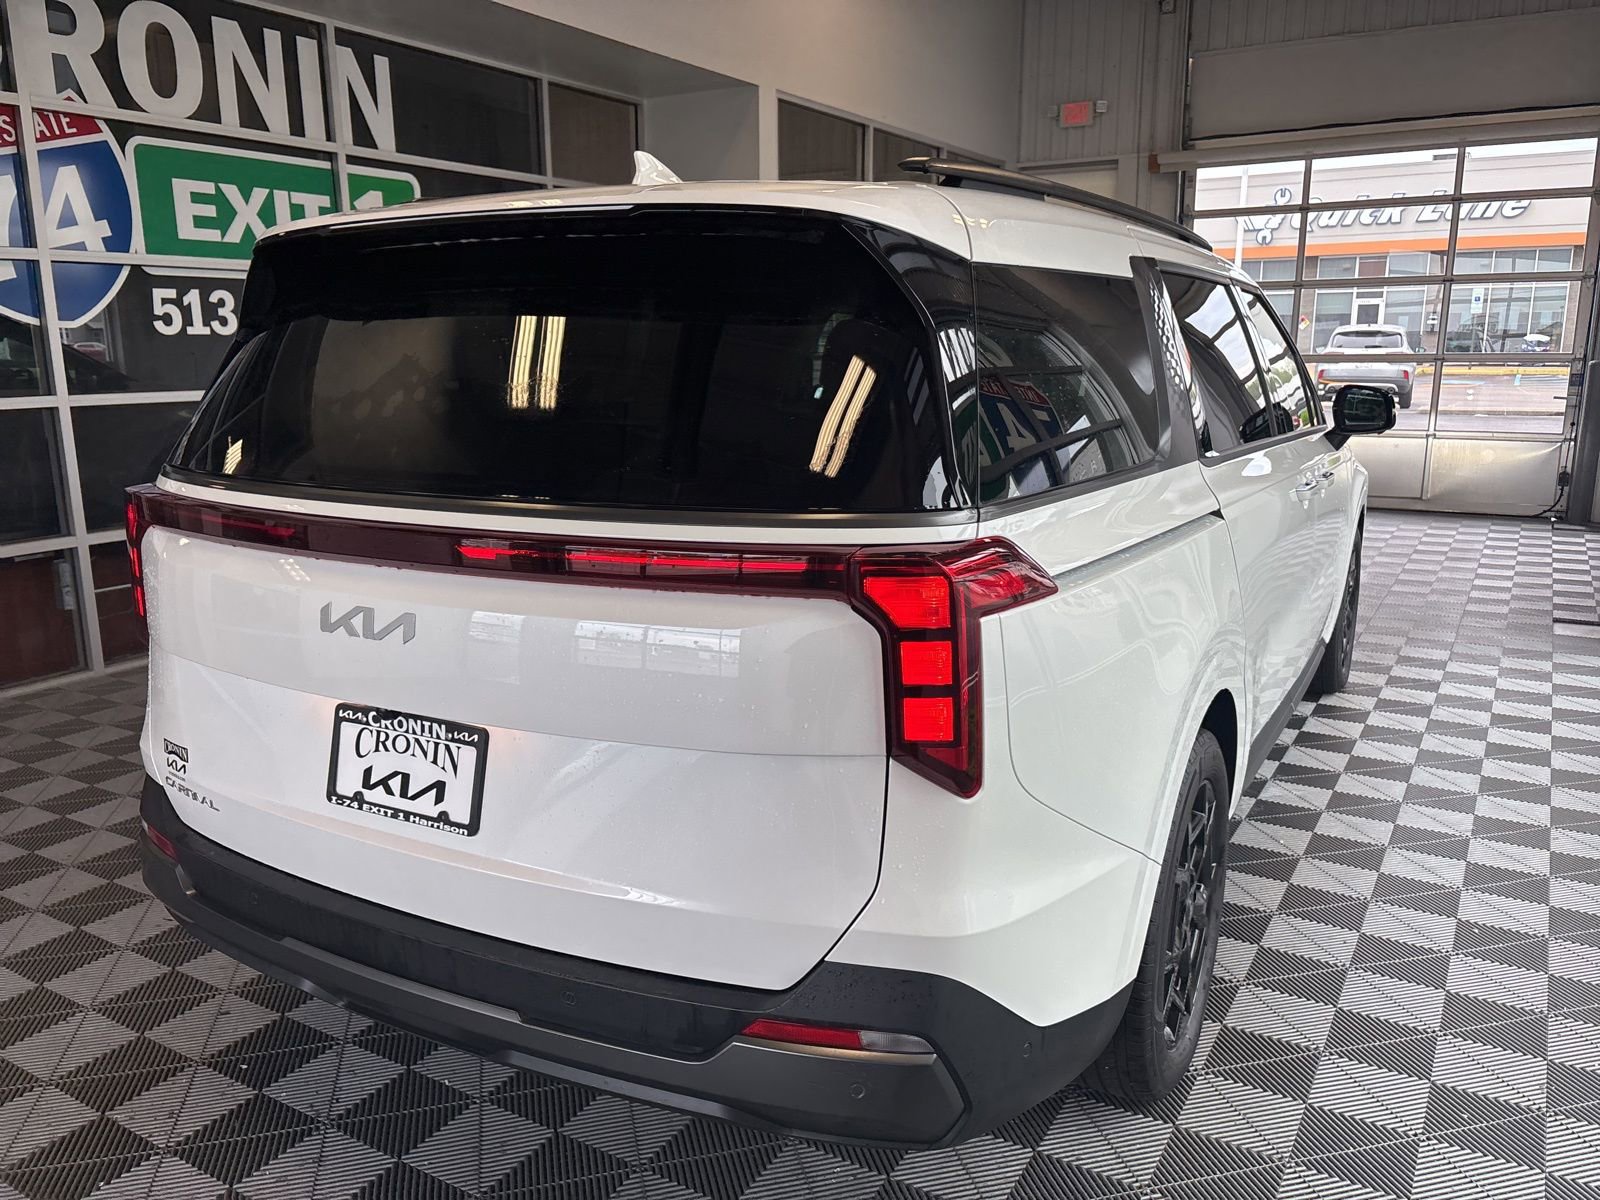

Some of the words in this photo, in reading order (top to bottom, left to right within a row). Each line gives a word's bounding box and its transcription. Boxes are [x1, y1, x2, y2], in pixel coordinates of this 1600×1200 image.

[0, 0, 397, 153] RONIN
[171, 177, 332, 244] EXIT
[151, 287, 239, 336] 513
[320, 601, 417, 645] KIA
[368, 711, 447, 741] CRONIN
[355, 727, 462, 780] CRONIN
[362, 765, 447, 806] KIA
[331, 795, 360, 810] I-74
[362, 803, 395, 818] EXIT
[397, 812, 406, 821] 1
[409, 815, 469, 837] Harrison
